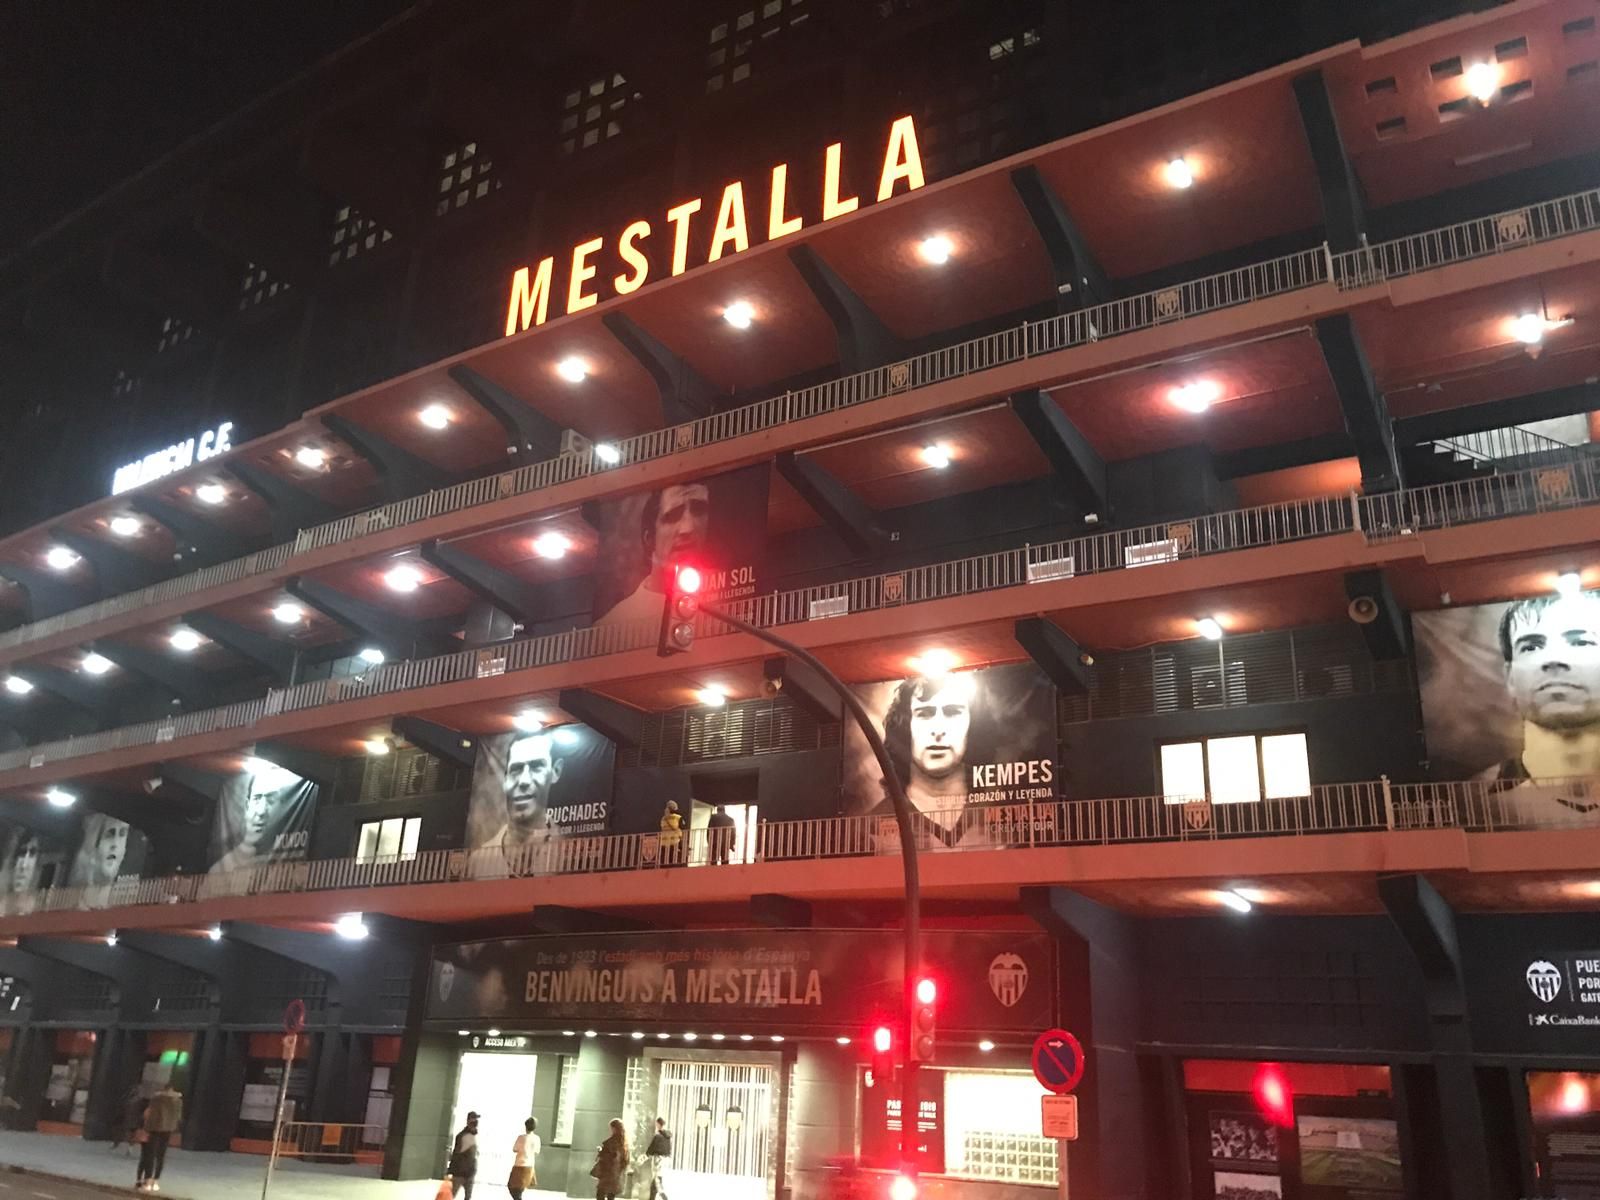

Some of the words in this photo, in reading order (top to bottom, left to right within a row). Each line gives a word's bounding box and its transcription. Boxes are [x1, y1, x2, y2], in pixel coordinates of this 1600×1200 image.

[505, 115, 926, 337] MESTALLA
[730, 566, 756, 587] SOL
[972, 759, 1053, 788] KEMPES
[968, 789, 1006, 804] CORAZÓN
[1008, 790, 1015, 800] Y
[1015, 787, 1053, 800] LEYENDA
[545, 801, 607, 824] PUCHADES
[273, 830, 309, 850] MUNDO
[570, 949, 597, 964] 1923
[525, 969, 655, 1003] BENVINGUTS
[661, 968, 677, 1003] A
[686, 967, 822, 1005] MESTALLA
